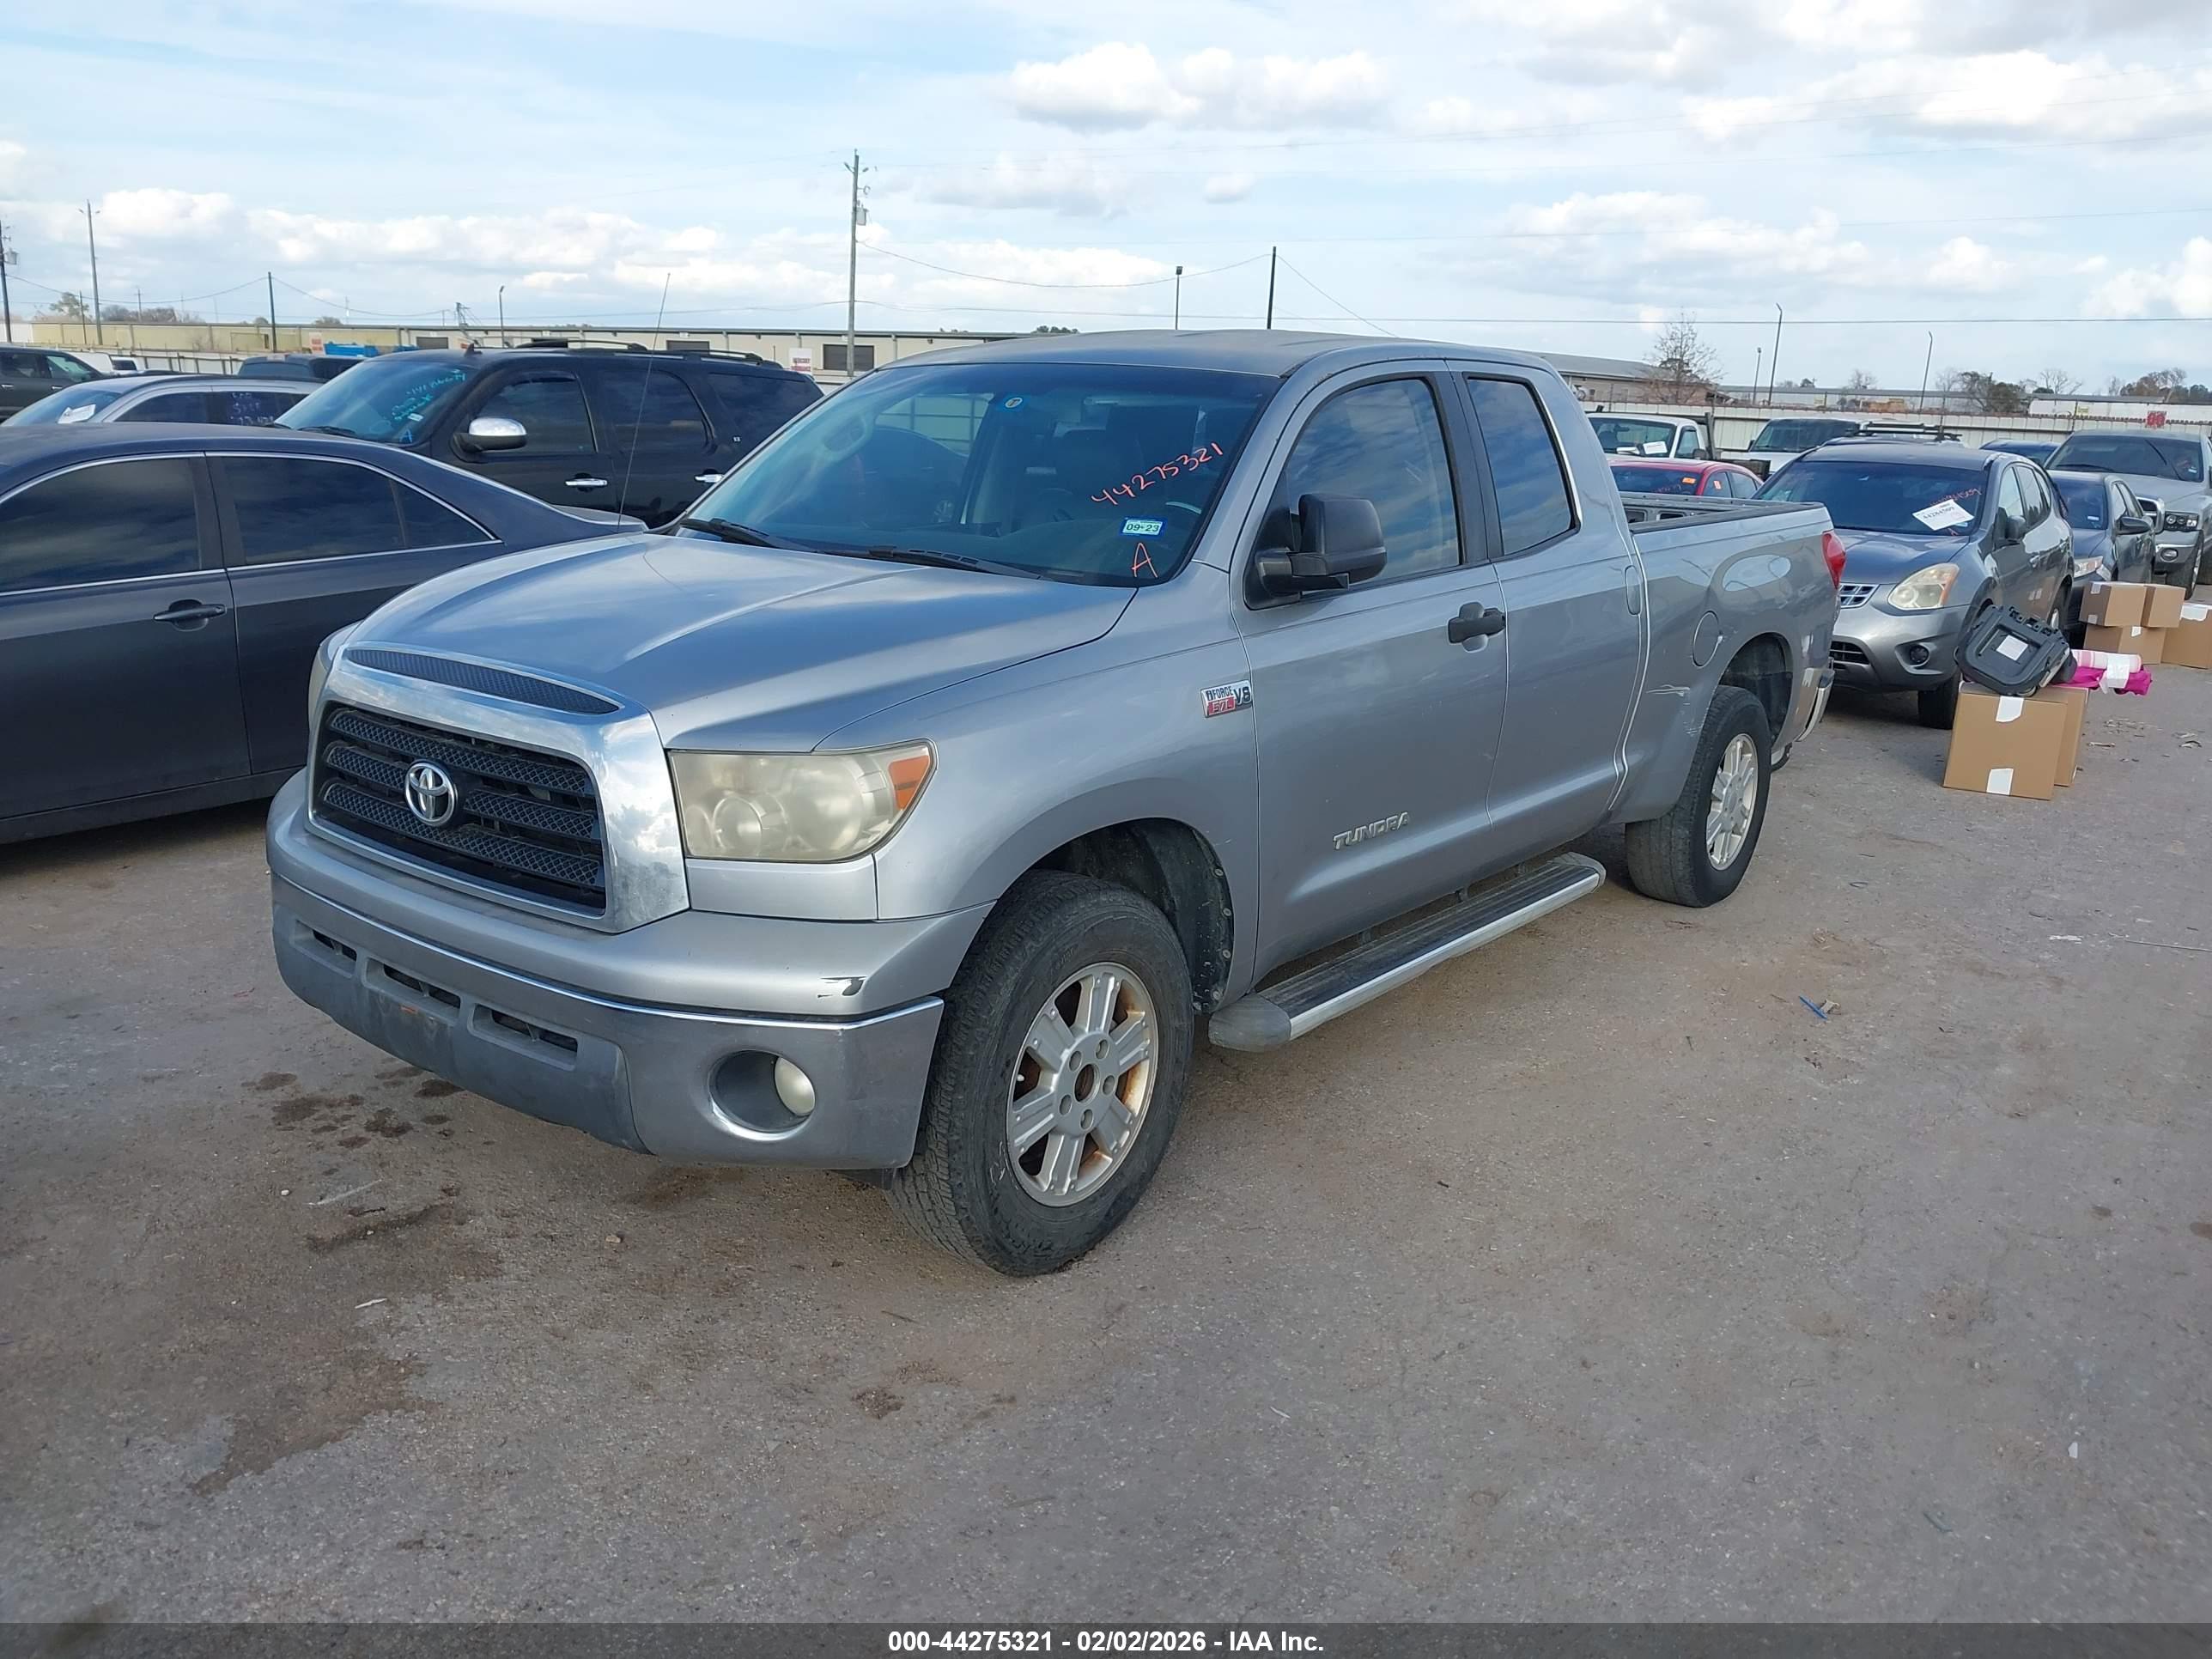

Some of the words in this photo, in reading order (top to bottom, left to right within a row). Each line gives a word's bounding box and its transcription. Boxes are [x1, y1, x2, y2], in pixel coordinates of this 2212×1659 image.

[1091, 442, 1224, 506] 44275321
[1131, 542, 1158, 579] A
[1234, 686, 1251, 705] V8
[1333, 811, 1410, 850] TUNDRA
